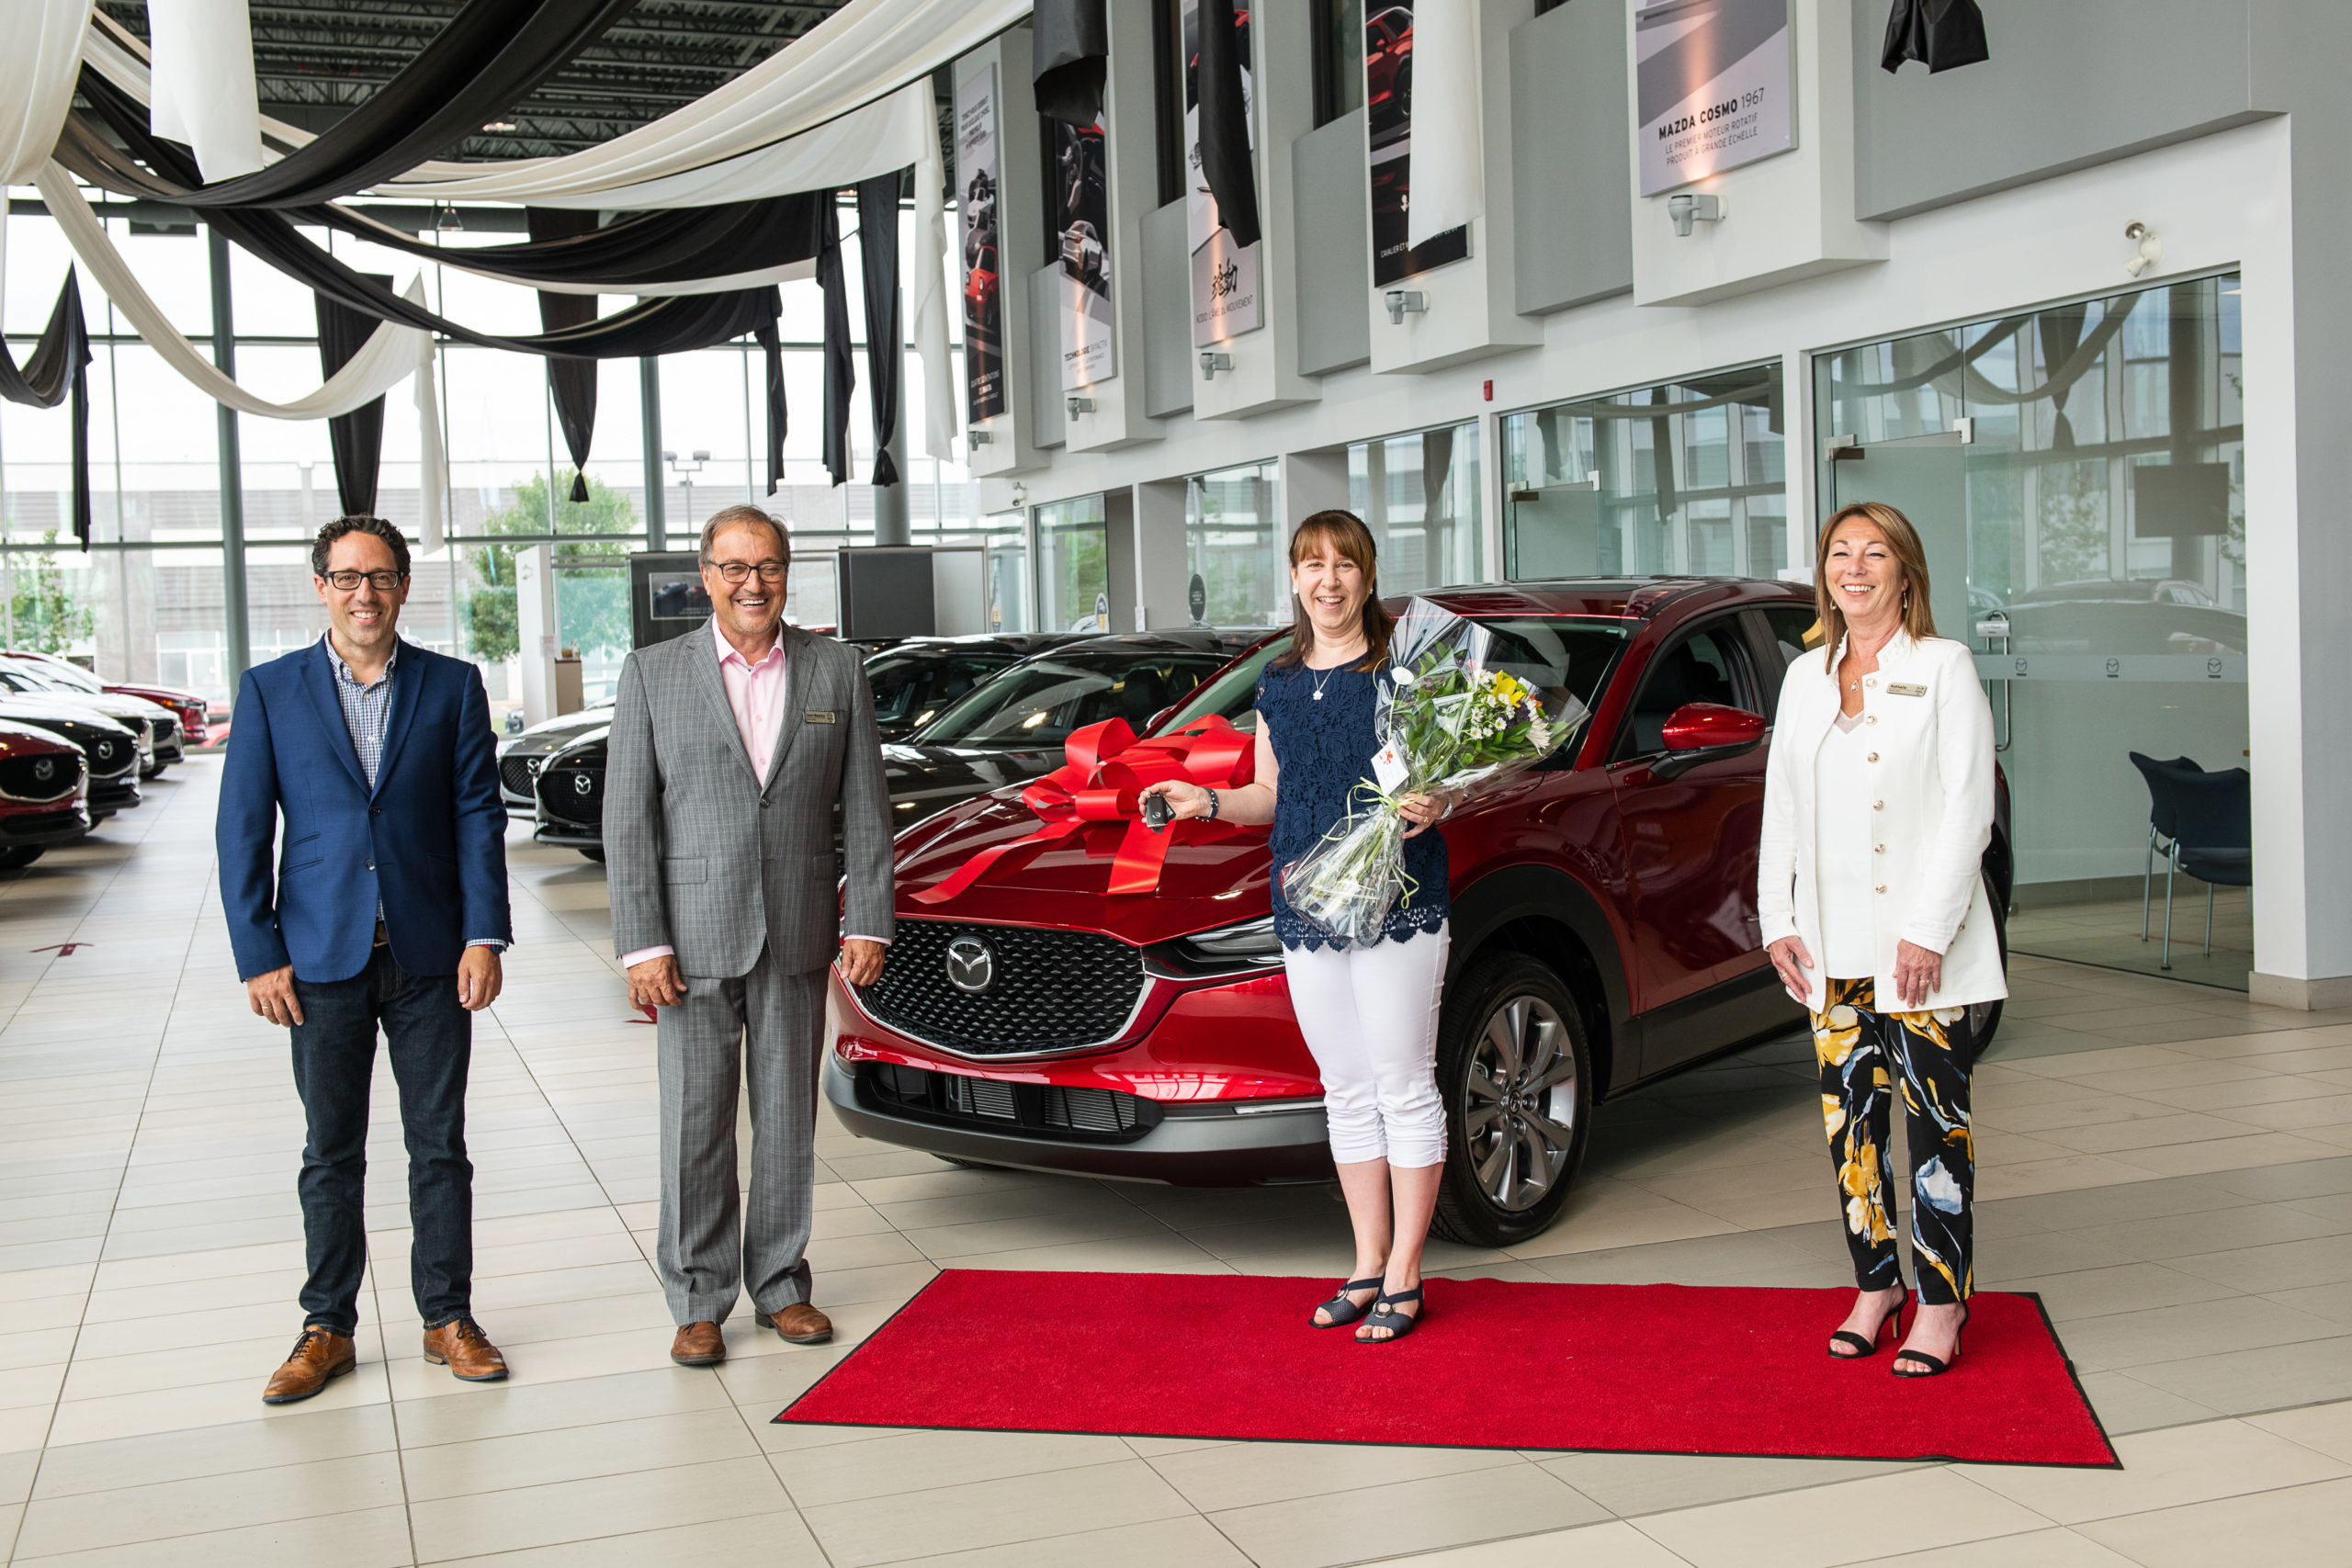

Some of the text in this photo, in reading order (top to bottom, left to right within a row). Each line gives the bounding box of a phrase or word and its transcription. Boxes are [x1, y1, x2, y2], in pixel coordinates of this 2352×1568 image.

[1658, 86, 1765, 141] MAZDA COSMO 1967
[1665, 112, 1758, 154] LE PREMIER MOTEUR ROTATIF
[1666, 149, 1692, 166] PRODUIT
[1701, 137, 1726, 153] GRANDE
[1728, 125, 1758, 146] ÉCHELLE
